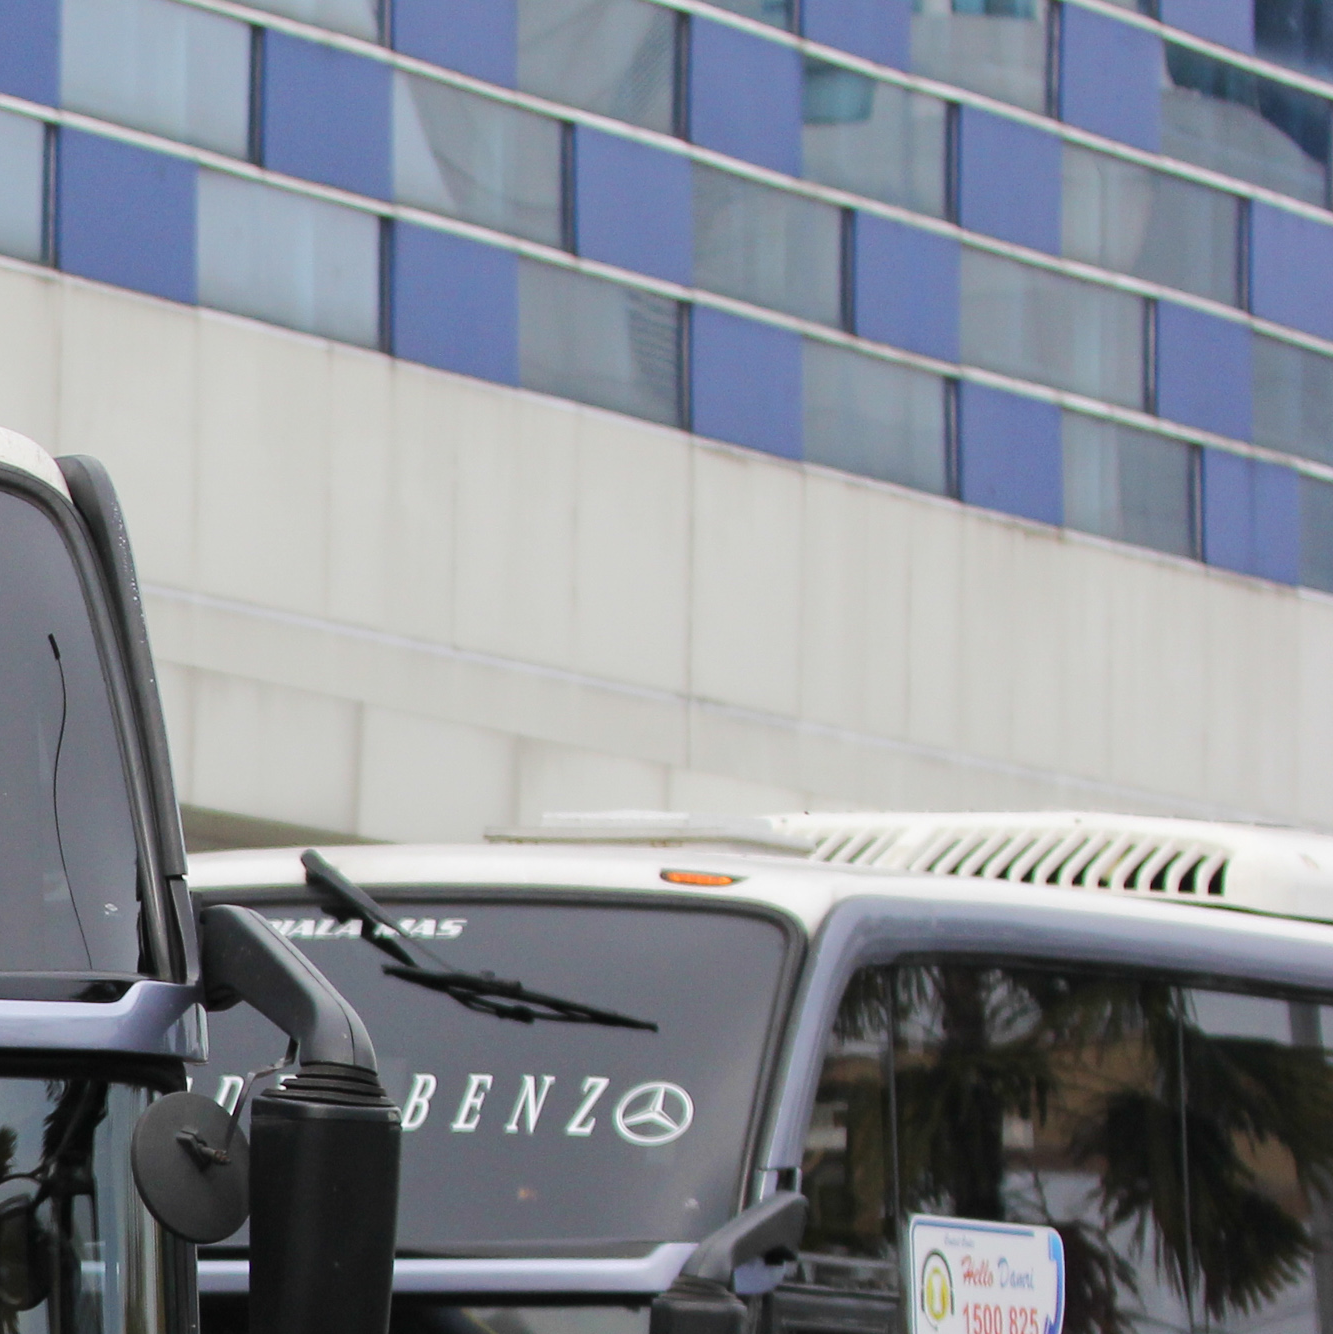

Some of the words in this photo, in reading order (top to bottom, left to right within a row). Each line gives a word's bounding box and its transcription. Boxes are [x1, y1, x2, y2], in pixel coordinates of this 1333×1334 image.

[268, 918, 363, 938] IALA
[401, 1073, 610, 1137] BENZ
[961, 1255, 994, 1287] Hello
